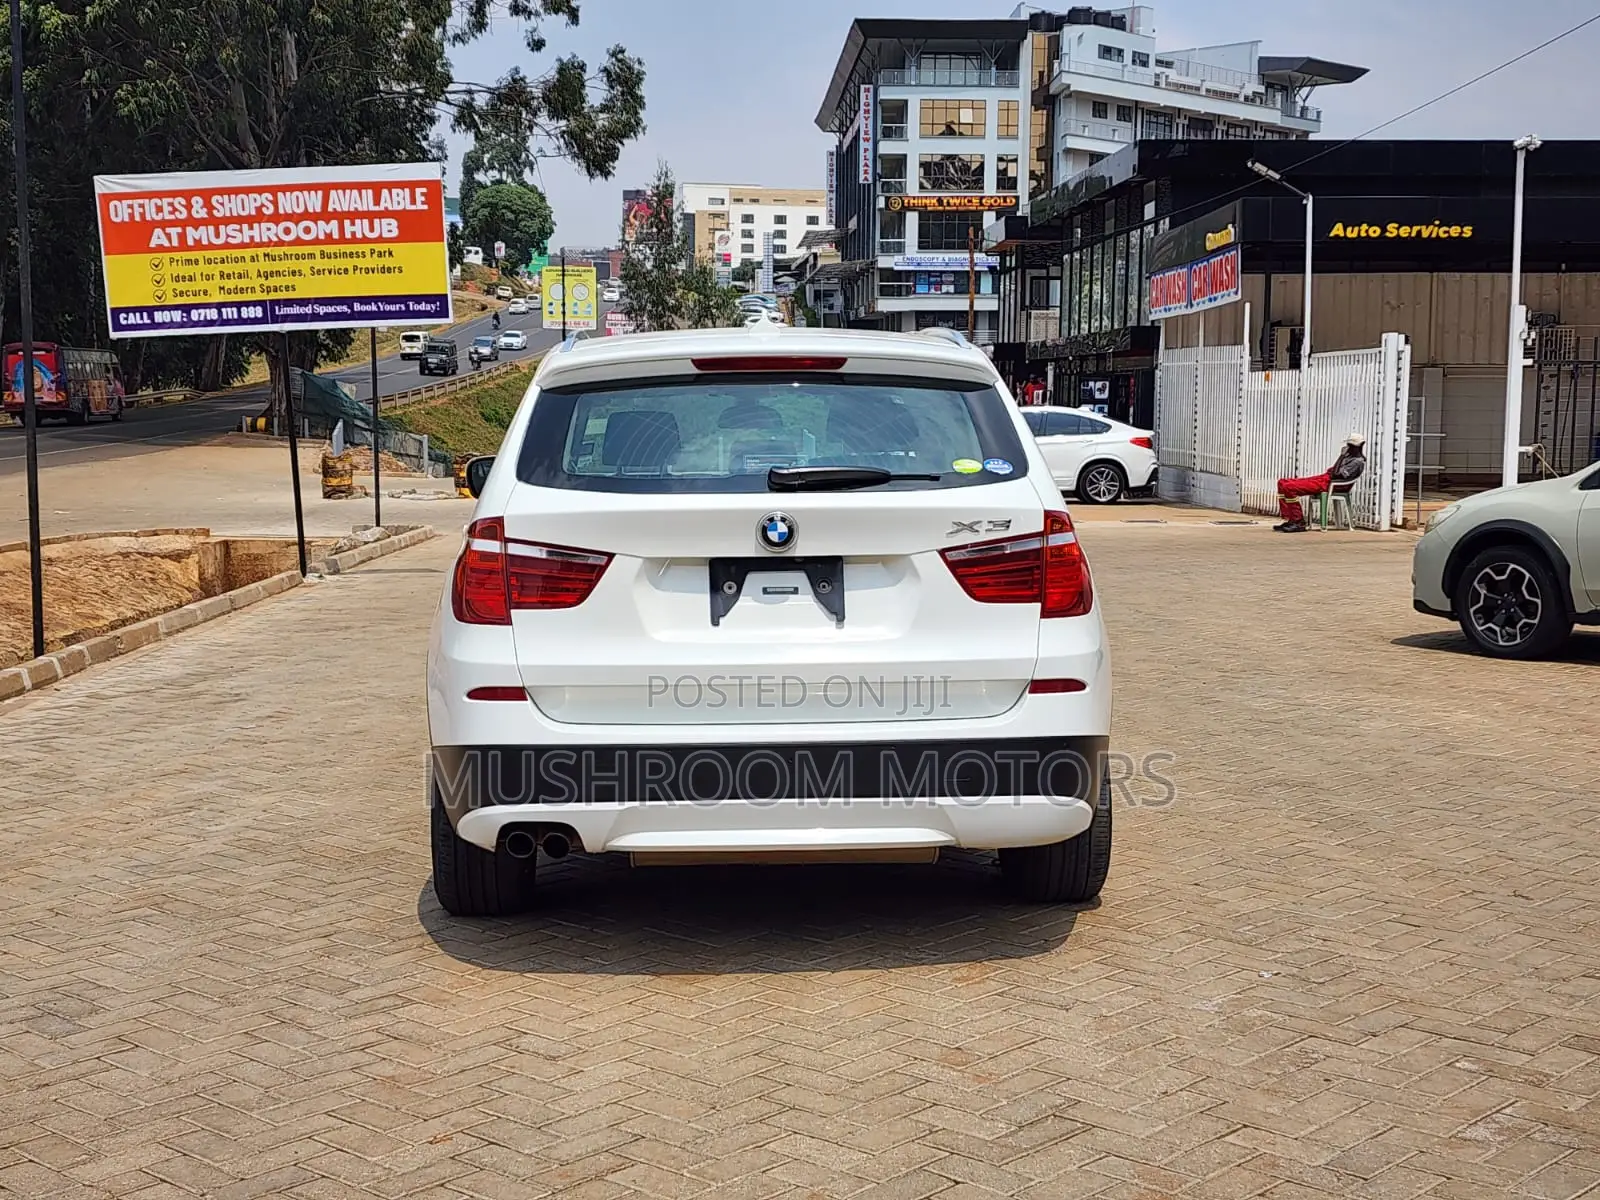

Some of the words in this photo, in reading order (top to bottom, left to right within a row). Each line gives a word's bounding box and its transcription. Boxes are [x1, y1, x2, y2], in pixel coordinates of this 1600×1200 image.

[862, 87, 871, 143] HIGHVIEW
[862, 147, 870, 182] PLAZA
[109, 197, 188, 223] OFFICES
[190, 195, 209, 219] &
[211, 192, 275, 218] SHOPS
[277, 190, 323, 214] NOW
[327, 187, 429, 212] AVAILABLE
[902, 196, 939, 207] THINK
[941, 196, 980, 206] TWICE
[982, 196, 1016, 206] GOLD
[149, 226, 182, 248] AT
[186, 219, 339, 246] MUSHROOM
[343, 217, 400, 239] HUB
[1329, 222, 1381, 238] Auto
[1385, 219, 1473, 238] Services
[169, 256, 200, 268] Prime
[203, 253, 246, 265] location
[250, 253, 260, 263] at
[263, 250, 316, 262] Mushroom
[319, 248, 367, 260] Business
[369, 247, 394, 259] Park
[170, 271, 197, 283] Ideal
[200, 271, 215, 281] for
[219, 269, 253, 281] Retail,
[256, 266, 306, 279] Agencies,
[309, 264, 349, 276] Service
[352, 263, 404, 275] Providers
[1191, 264, 1209, 301] CAR
[1209, 253, 1237, 295] WASH
[172, 287, 212, 298] Secure,
[218, 284, 256, 296] Modern
[259, 283, 297, 295] Spaces
[1150, 275, 1164, 309] CAR
[1165, 270, 1187, 306] WASH
[119, 311, 151, 325] CALL
[153, 310, 188, 323] NOW:
[220, 307, 238, 319] 111
[240, 306, 263, 319] 888
[275, 303, 313, 316] Limited
[313, 303, 351, 316] Spaces,
[353, 302, 378, 312] Book
[377, 301, 406, 312] Yours
[407, 301, 440, 313] Today!
[945, 519, 1012, 537] X3
